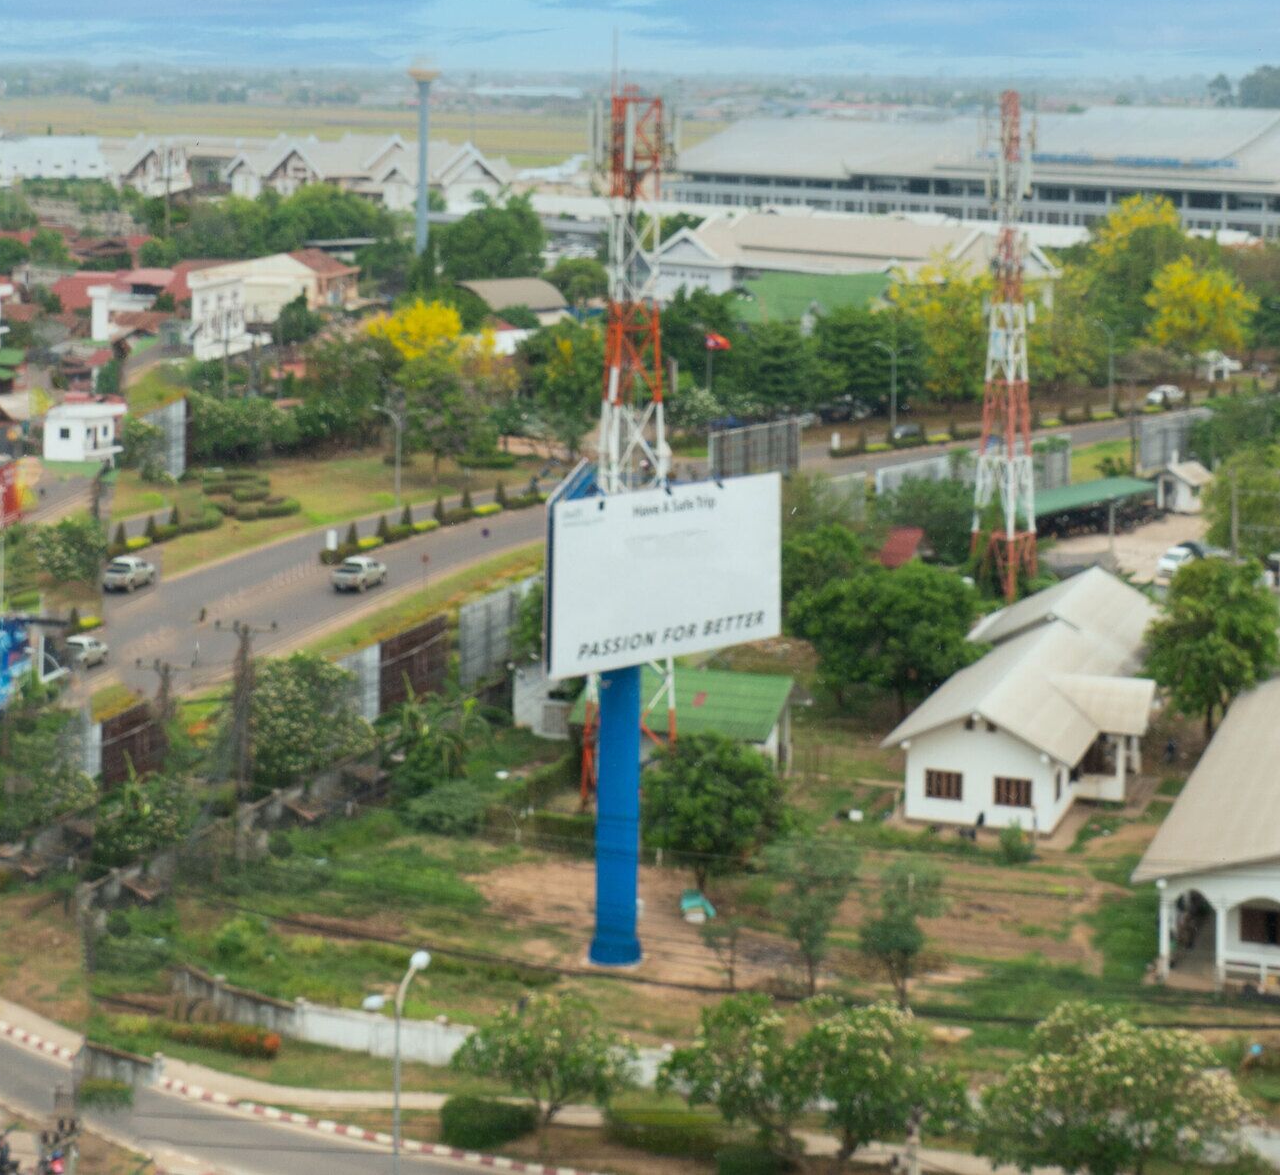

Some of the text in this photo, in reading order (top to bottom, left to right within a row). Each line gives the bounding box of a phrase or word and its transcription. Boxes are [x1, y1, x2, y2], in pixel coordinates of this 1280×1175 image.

[633, 504, 659, 517] Have
[672, 499, 694, 512] Safe
[696, 496, 716, 510] Trip
[577, 610, 765, 659] PASSION FOR BETTER
